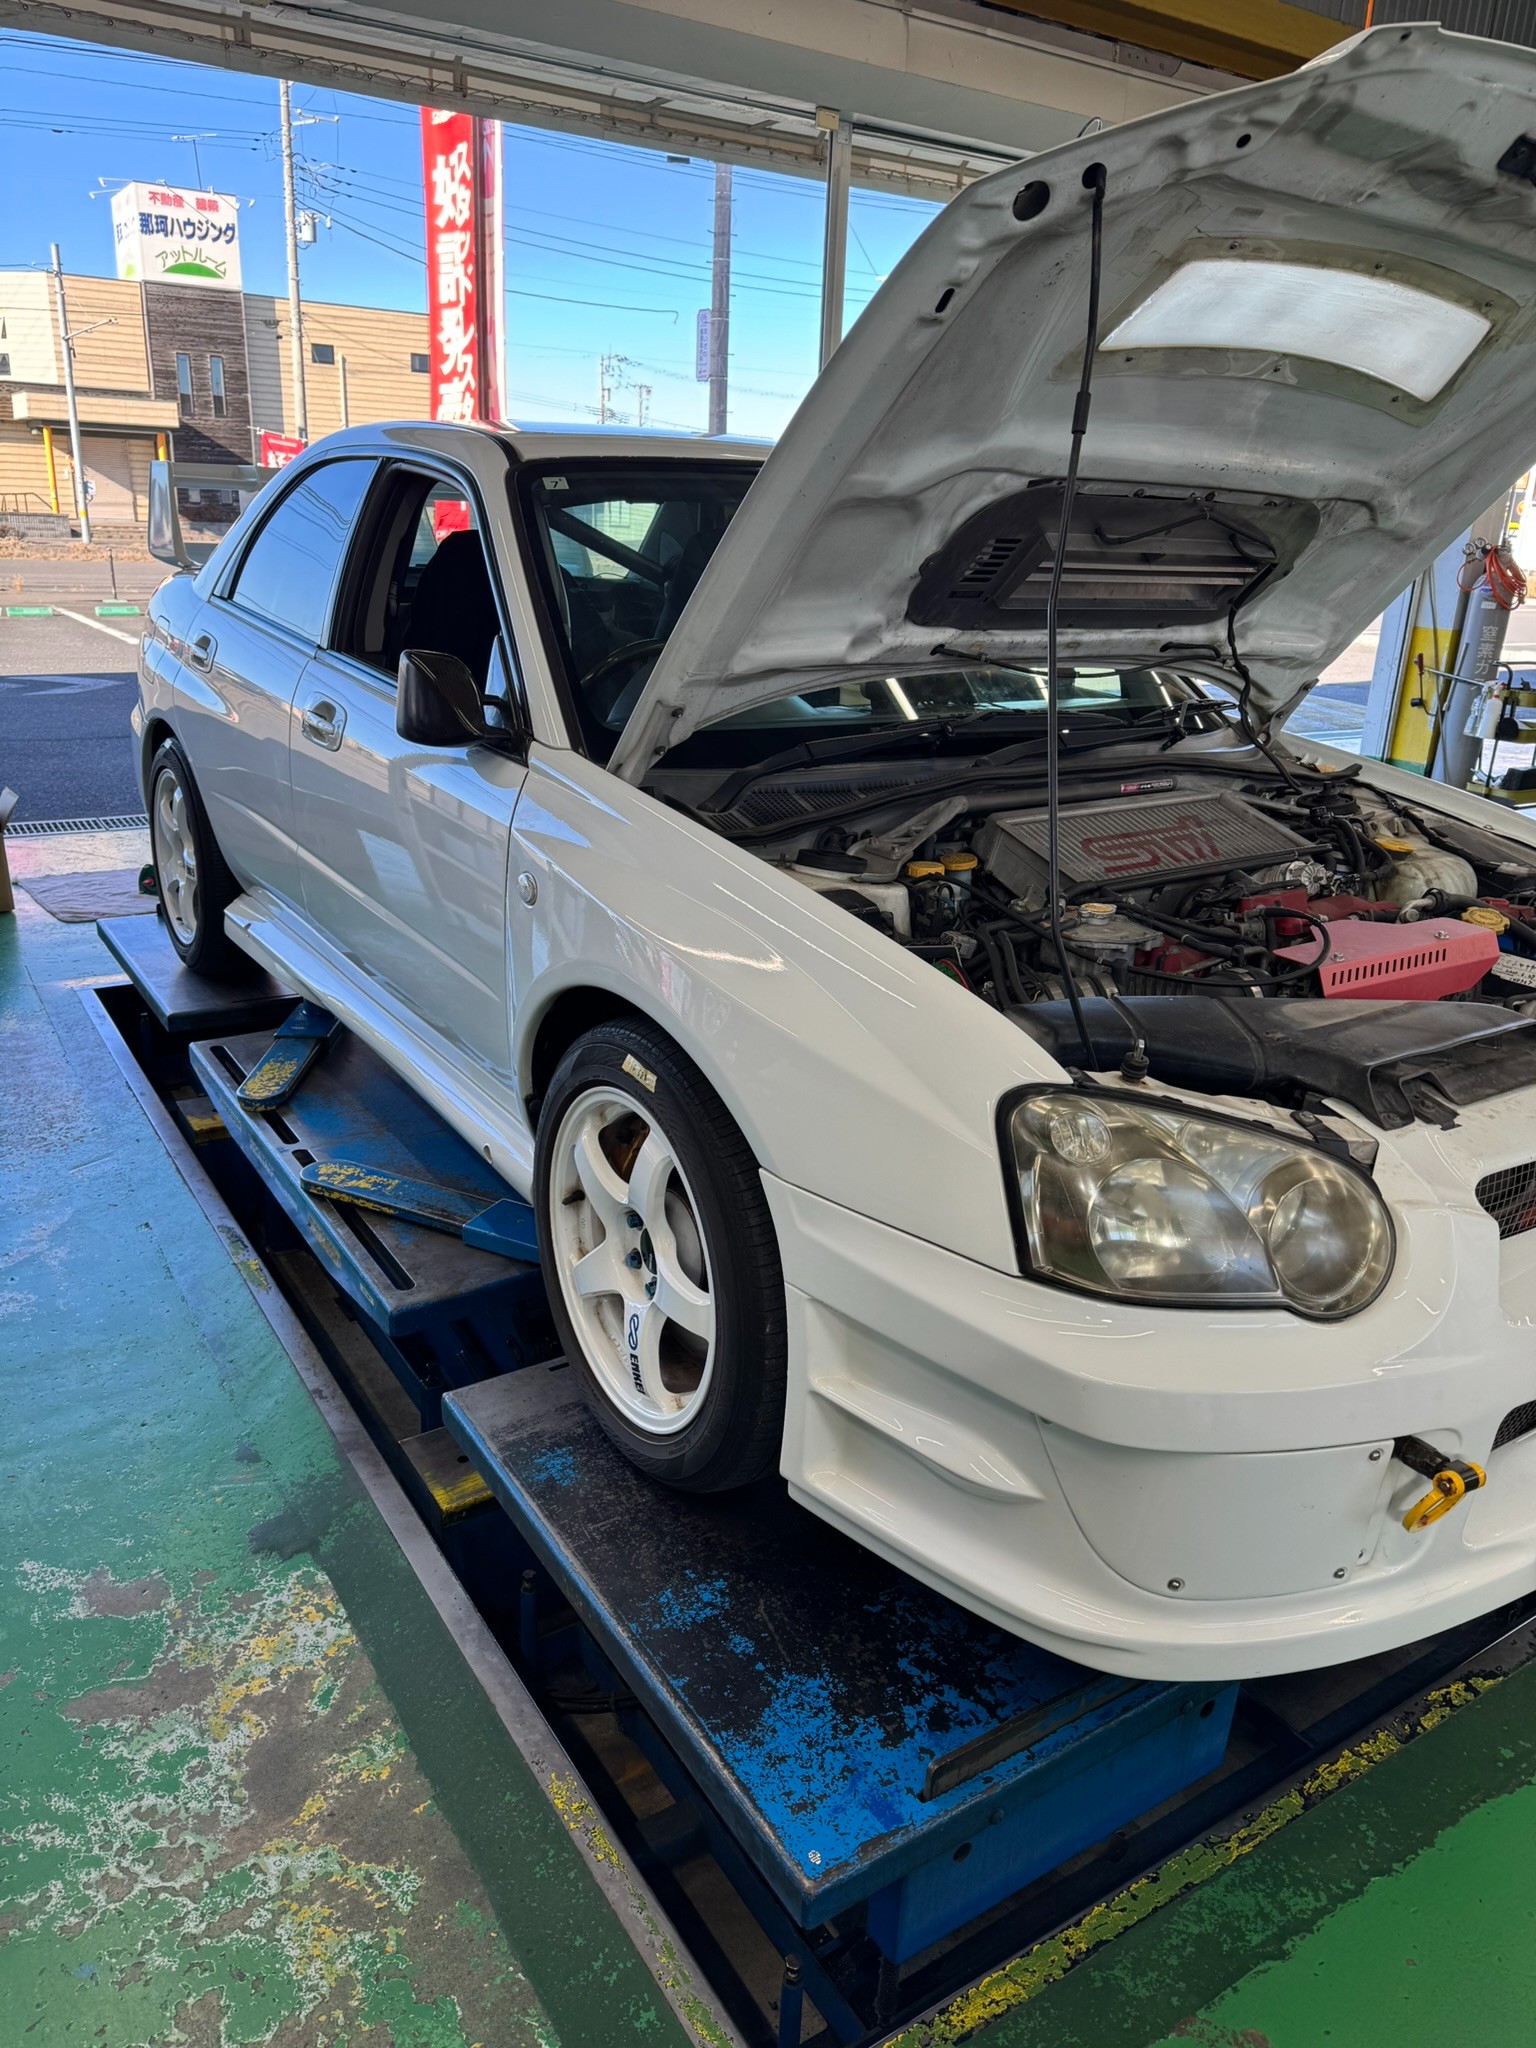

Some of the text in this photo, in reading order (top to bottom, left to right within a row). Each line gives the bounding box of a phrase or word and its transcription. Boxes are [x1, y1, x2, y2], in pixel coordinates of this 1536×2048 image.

[148, 190, 184, 209] 不動産
[138, 211, 236, 245] 那珂ハウジング
[155, 245, 227, 278] アットルーム
[629, 1353, 648, 1396] ENKEI
